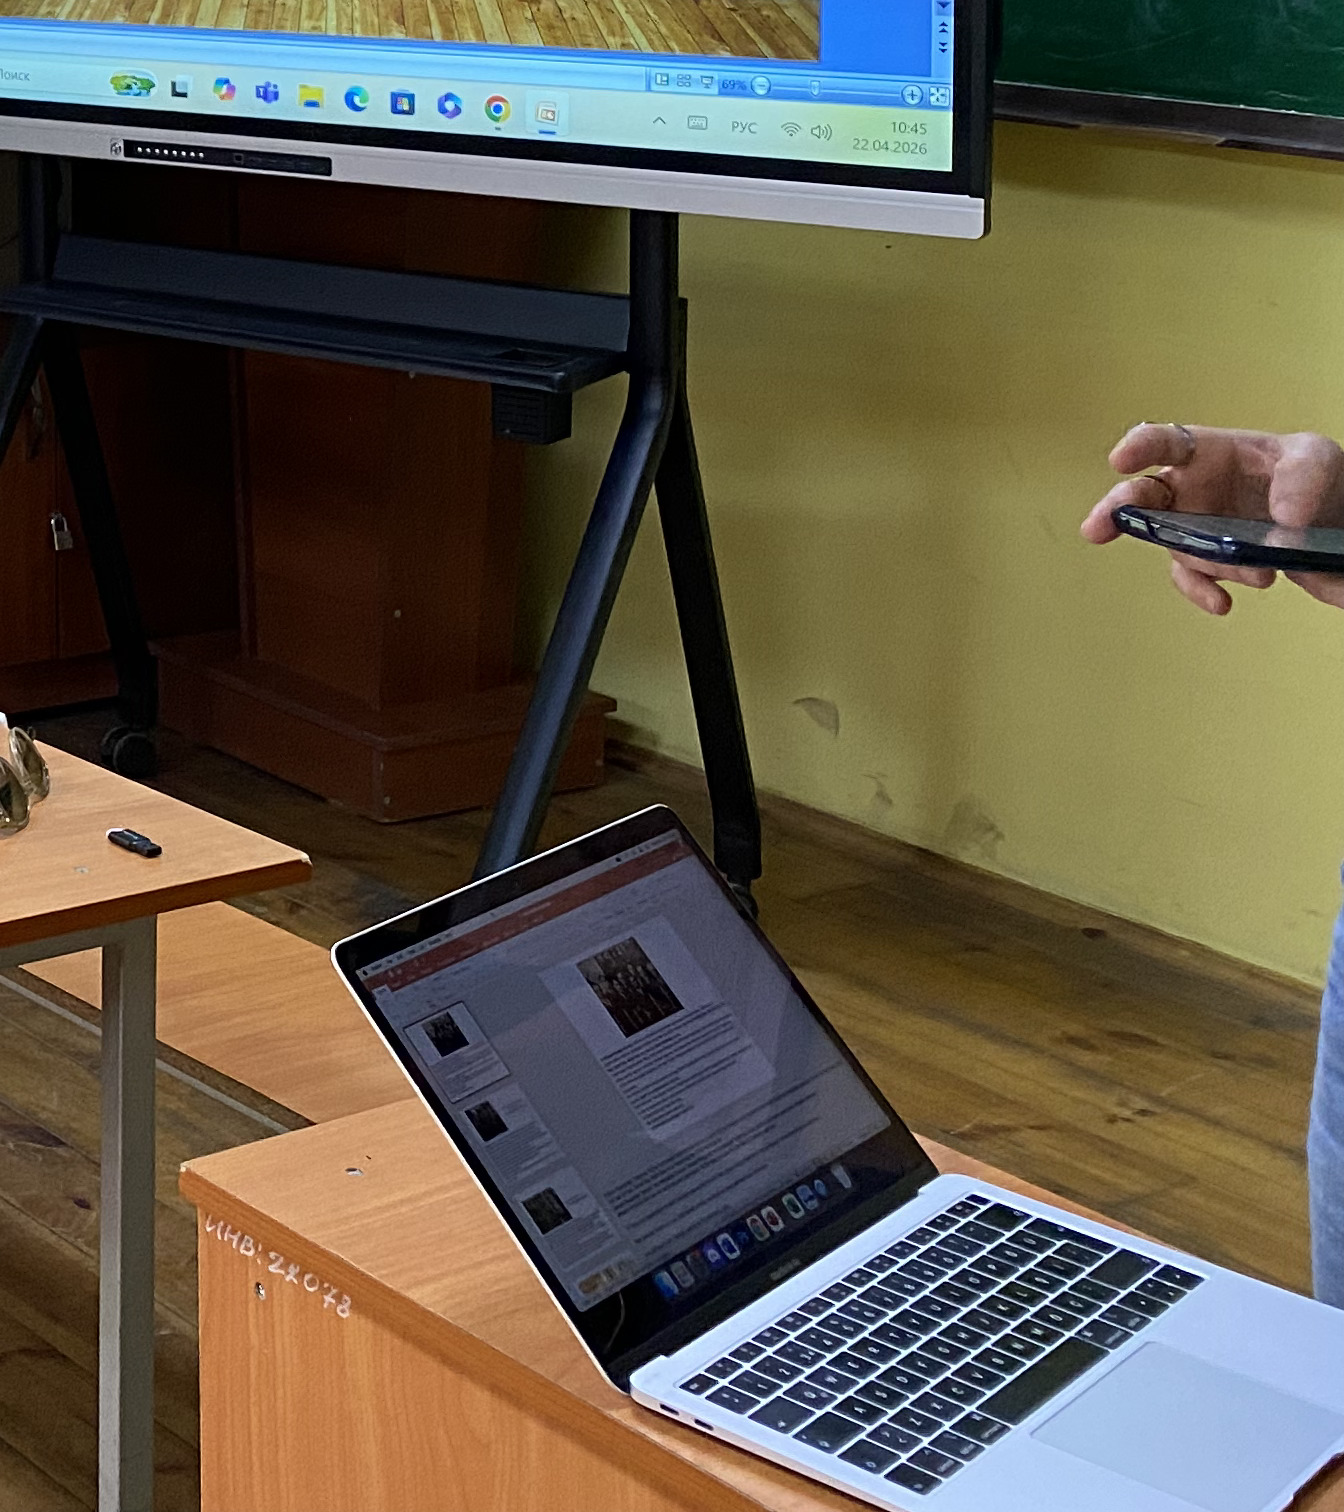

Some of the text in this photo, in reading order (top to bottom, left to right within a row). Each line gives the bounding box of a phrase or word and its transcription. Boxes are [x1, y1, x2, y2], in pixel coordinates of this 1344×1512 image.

[722, 79, 747, 90] 69%
[732, 121, 758, 135] РУС
[892, 120, 928, 136] 10:45
[853, 138, 928, 156] 22.04.2026
